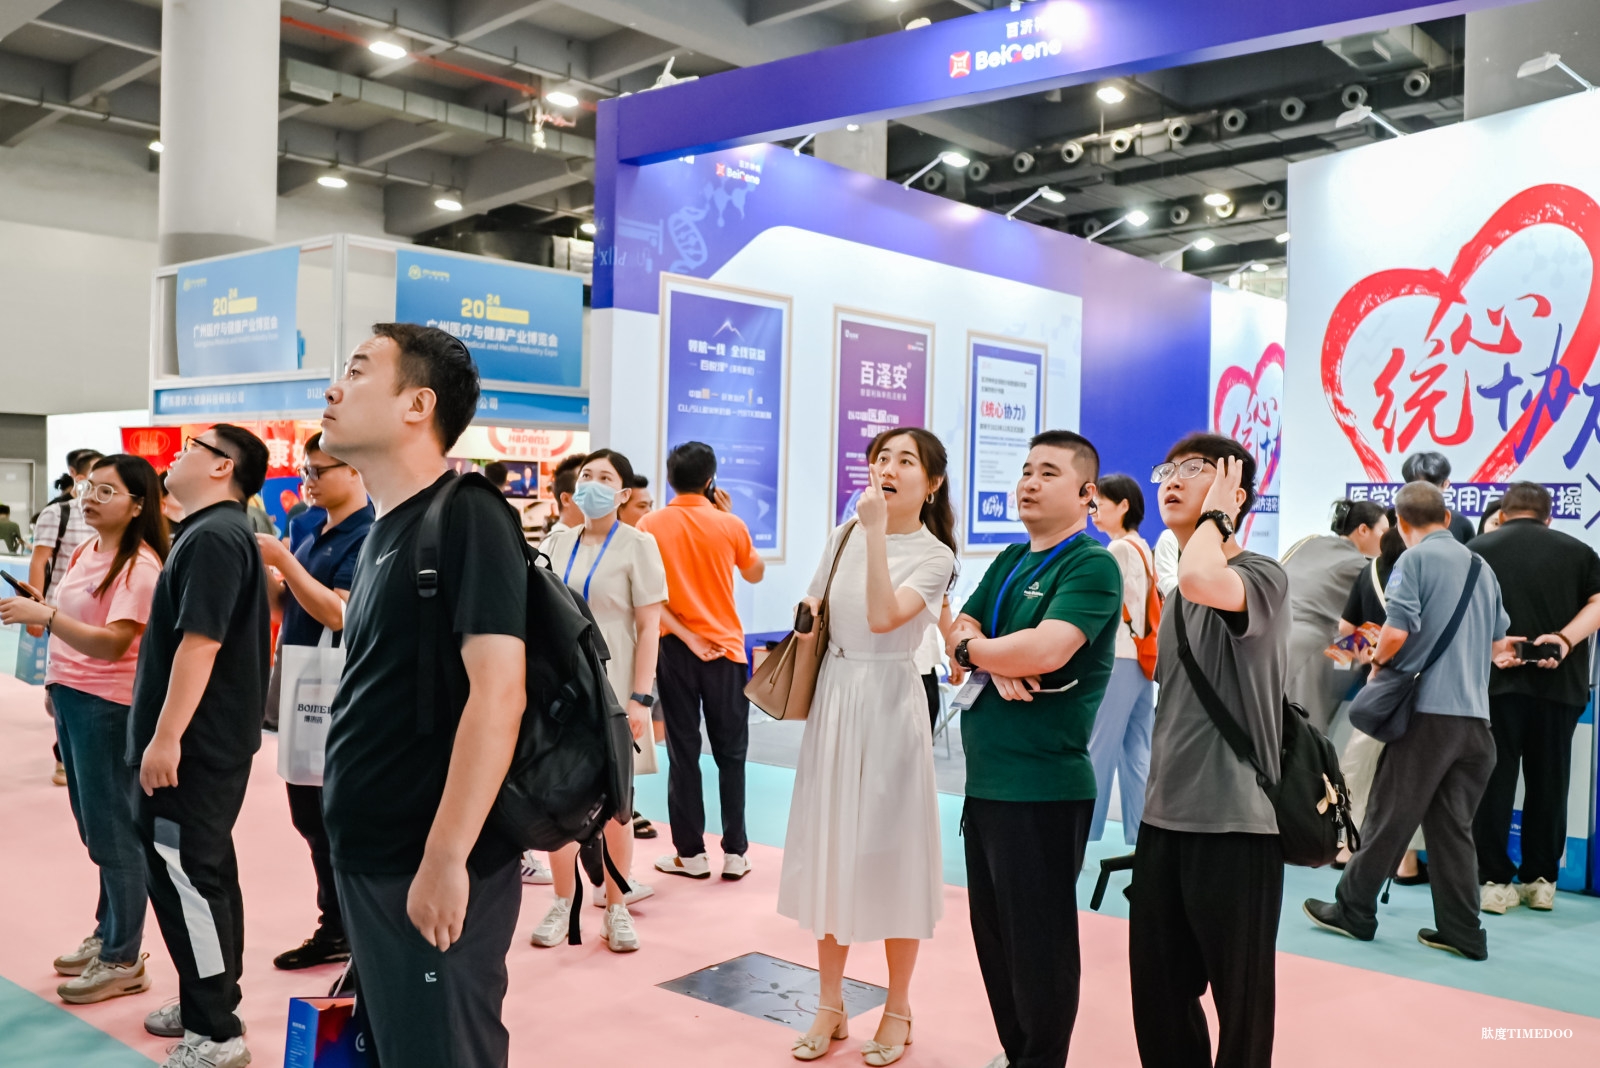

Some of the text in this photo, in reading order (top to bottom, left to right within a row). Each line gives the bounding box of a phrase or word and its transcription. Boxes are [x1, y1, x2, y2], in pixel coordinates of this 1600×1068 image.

[975, 39, 1062, 71] BeiGene
[726, 167, 760, 186] BeiGene
[213, 297, 228, 316] 20
[461, 294, 500, 319] 20 24
[981, 400, 1026, 421] 《统心协力》
